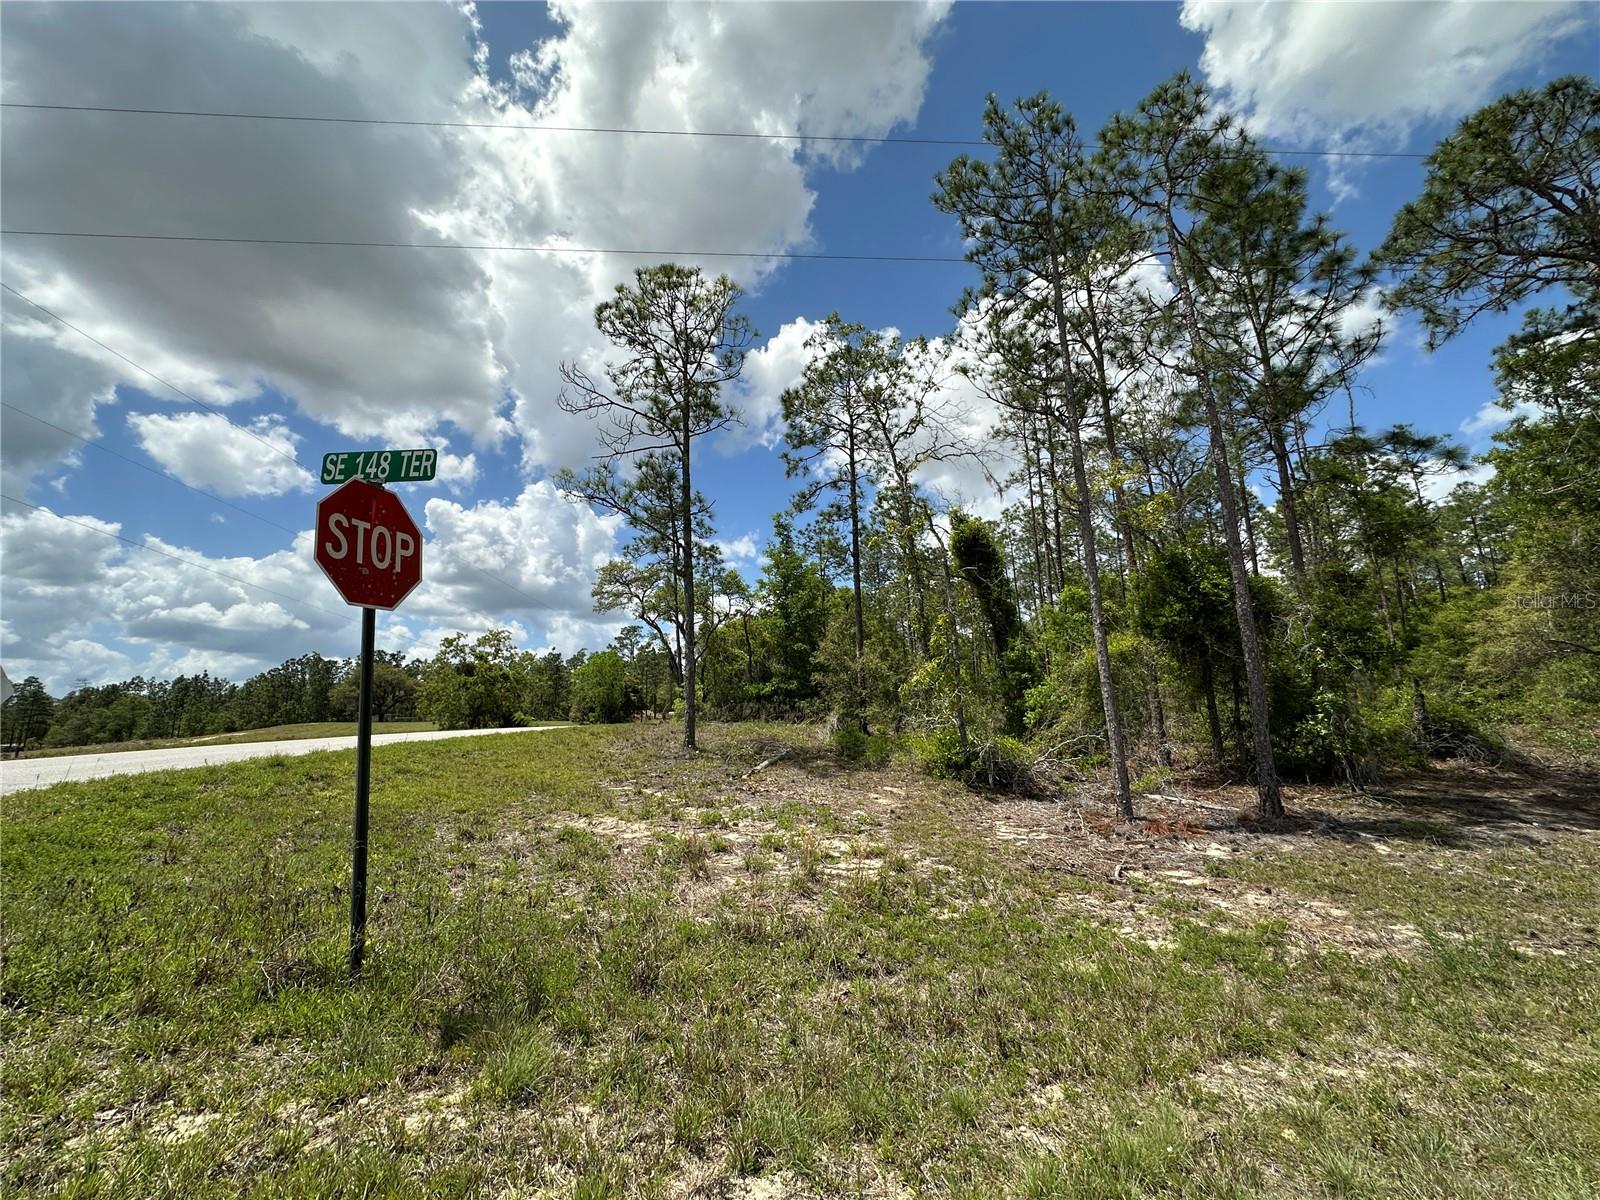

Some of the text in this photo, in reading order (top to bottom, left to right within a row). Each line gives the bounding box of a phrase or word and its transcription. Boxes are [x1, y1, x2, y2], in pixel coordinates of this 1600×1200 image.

[323, 450, 435, 480] SE 148 TER
[325, 512, 415, 573] STOP
